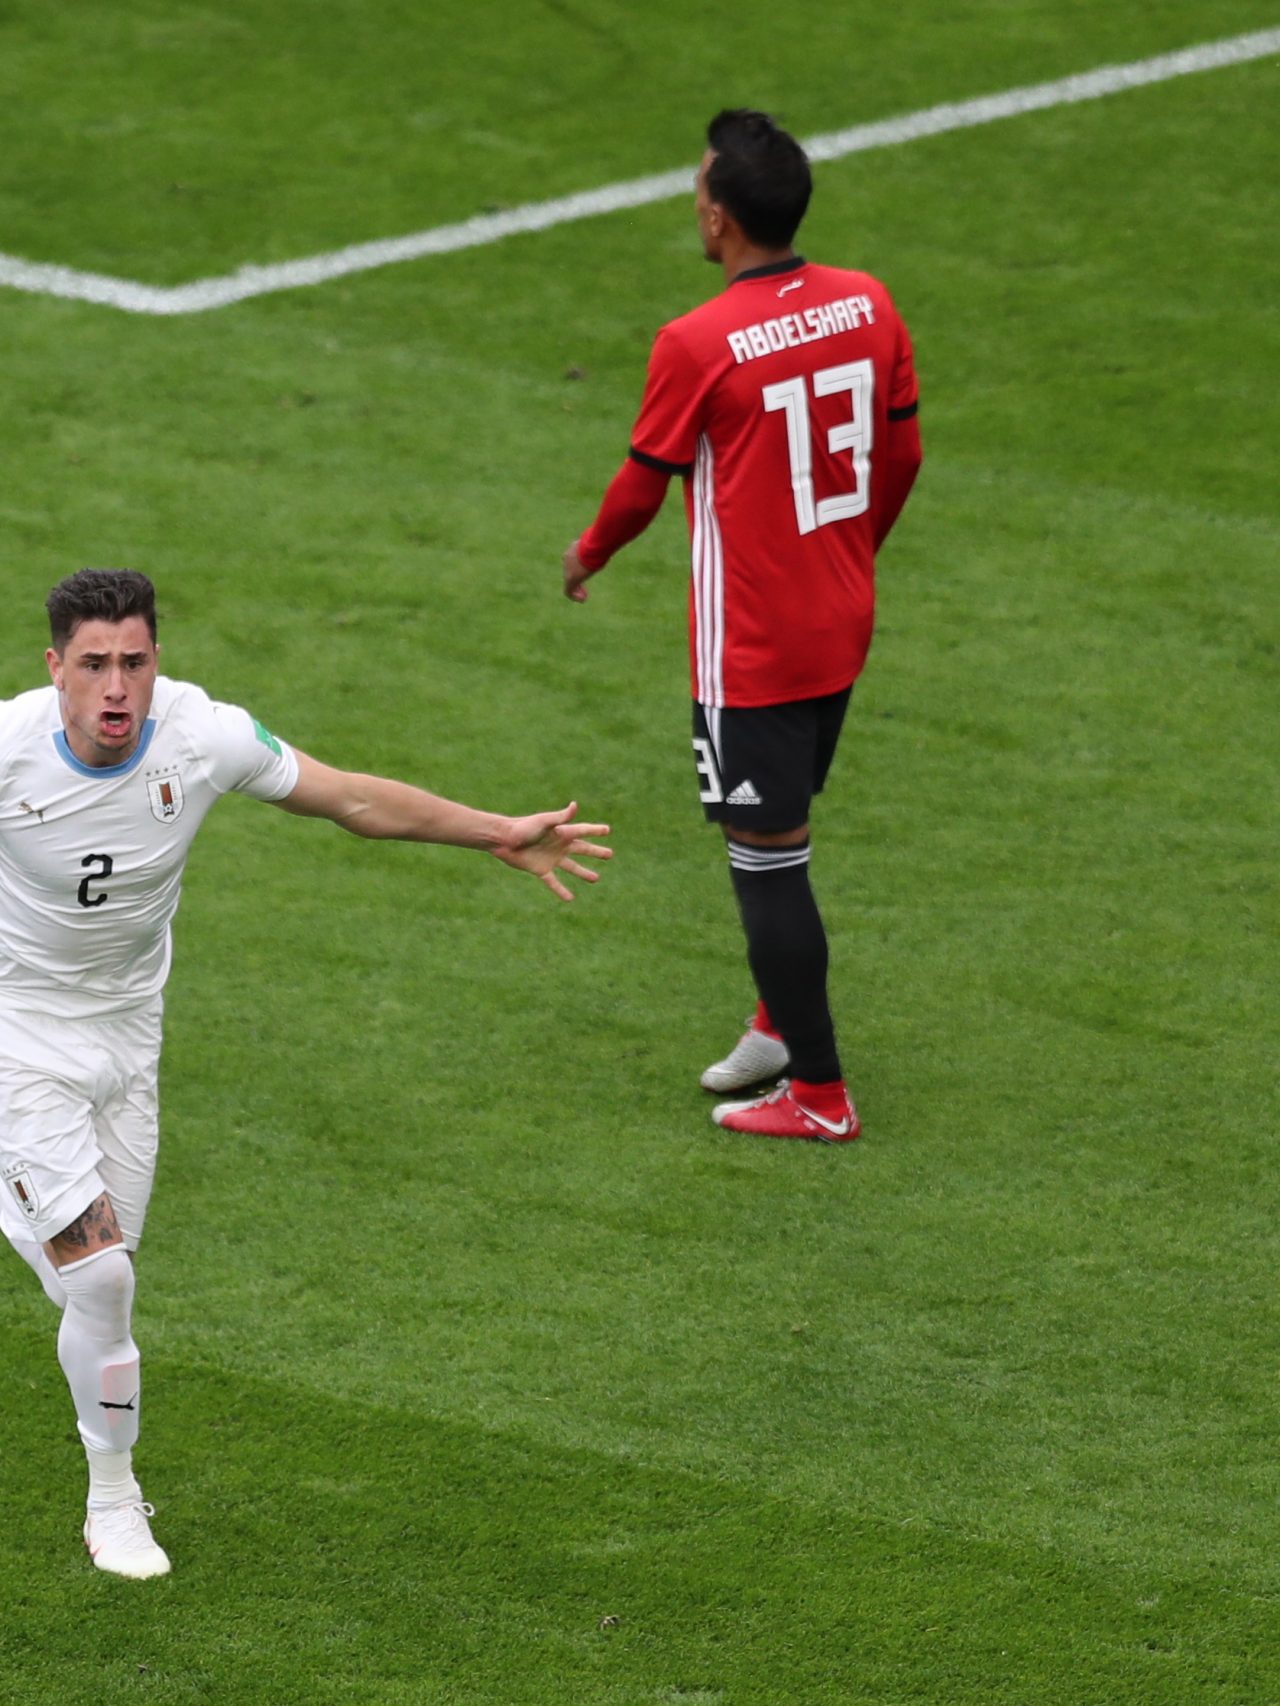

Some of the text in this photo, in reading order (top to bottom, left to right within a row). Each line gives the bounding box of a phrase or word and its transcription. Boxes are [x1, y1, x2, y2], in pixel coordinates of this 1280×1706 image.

[726, 293, 876, 364] ABDELSHAFY
[762, 357, 874, 535] 13
[77, 853, 113, 908] 2
